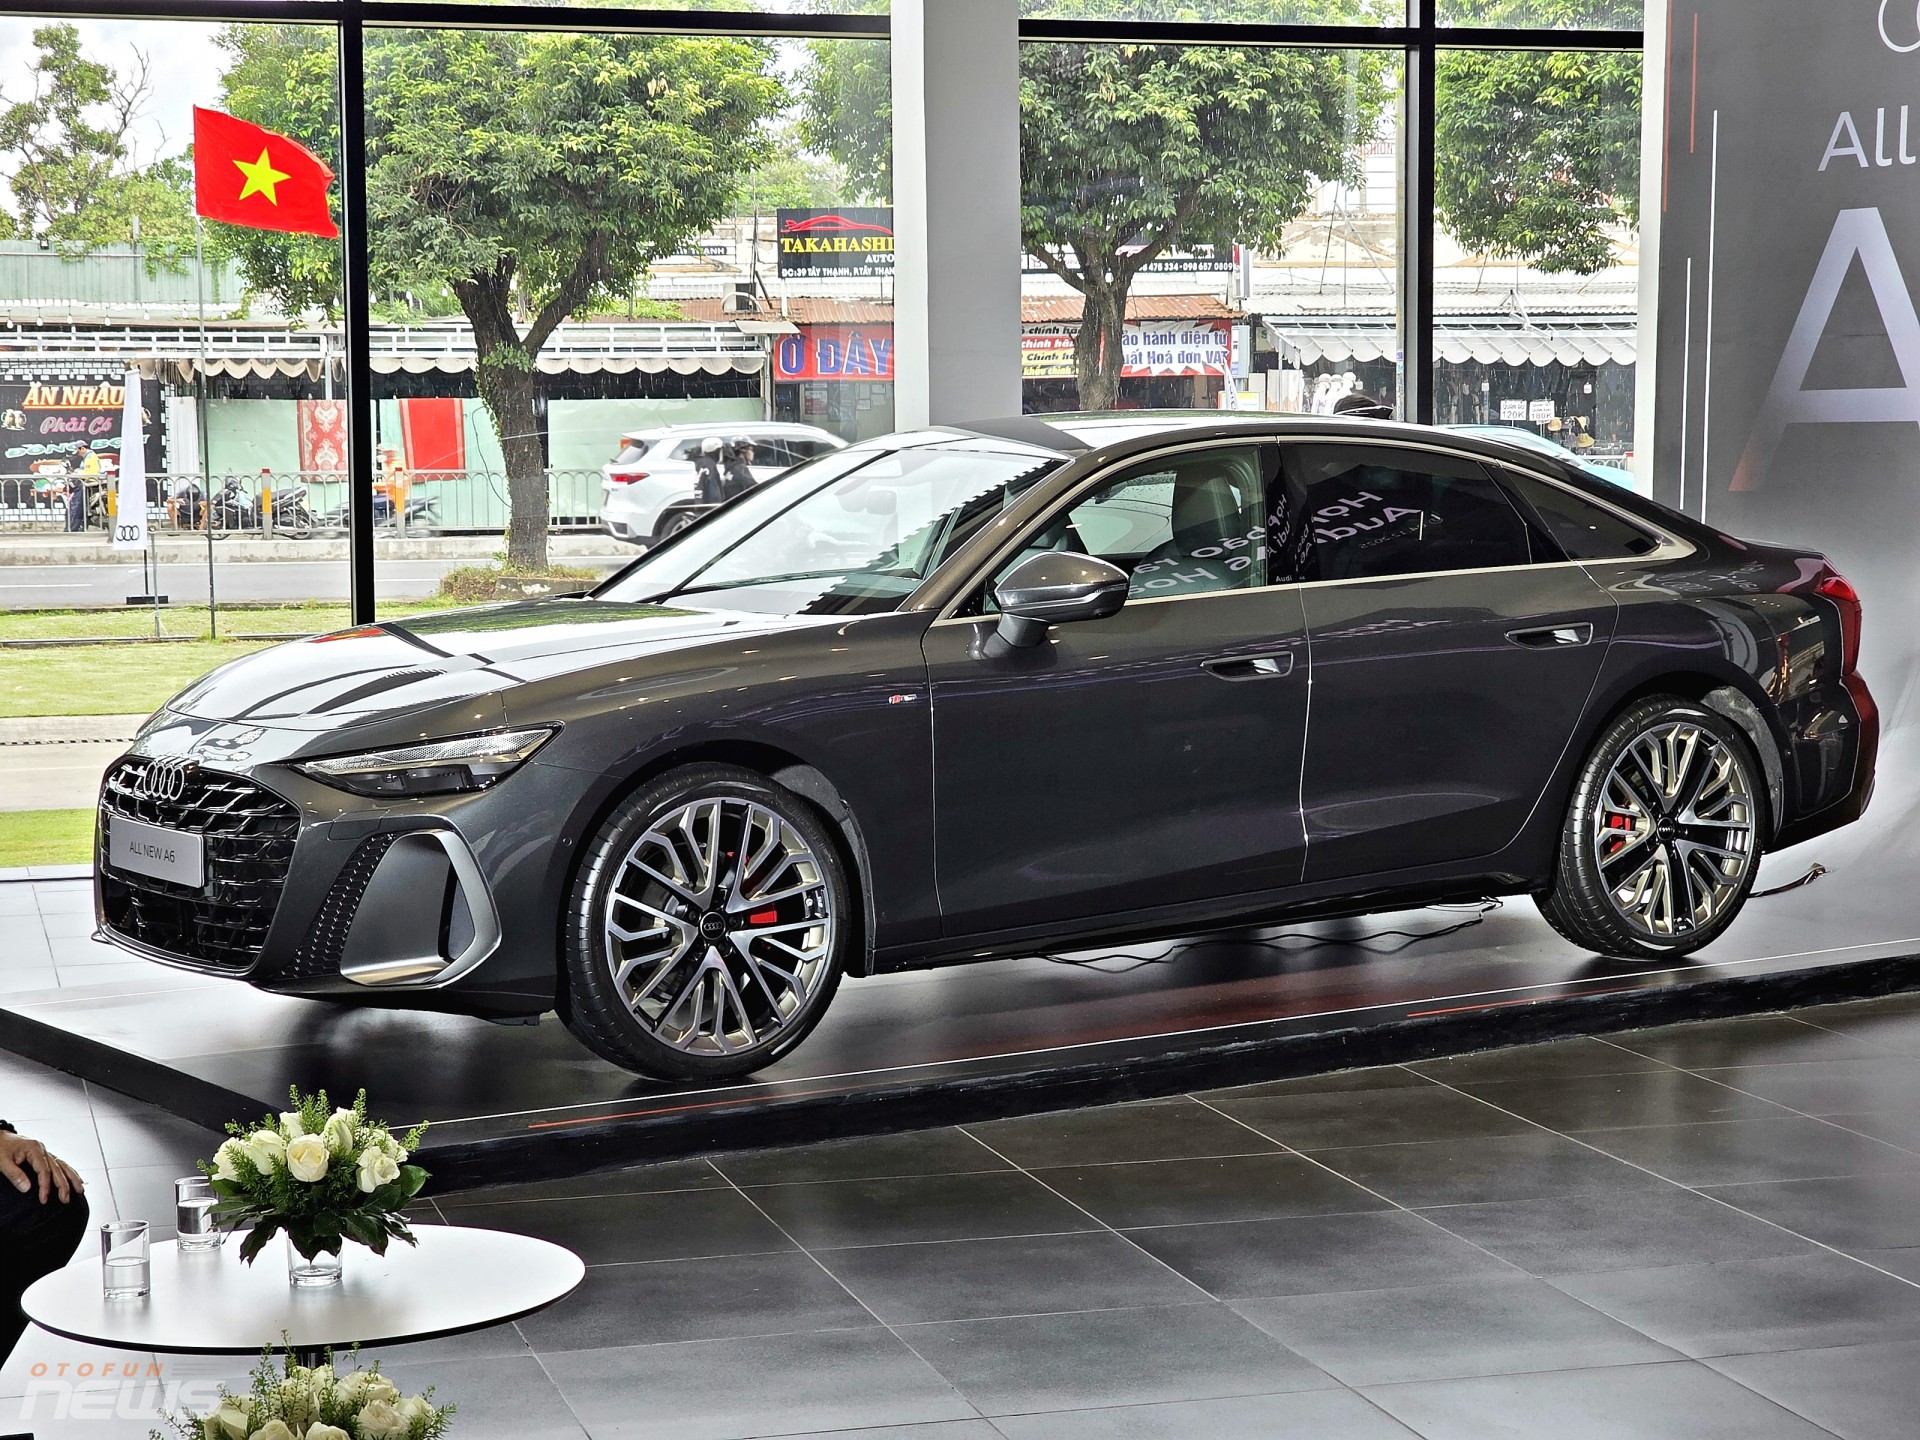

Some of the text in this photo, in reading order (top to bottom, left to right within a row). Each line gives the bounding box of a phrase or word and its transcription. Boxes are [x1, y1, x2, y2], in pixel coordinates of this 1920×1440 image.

[1817, 104, 1917, 172] All
[780, 236, 894, 253] TAKAHASHI
[865, 254, 894, 263] AUTO
[1121, 329, 1139, 346] ảo
[1142, 331, 1177, 346] hành
[1180, 330, 1210, 348] điện
[1213, 329, 1227, 345] tử
[816, 331, 892, 375] ĐÂY
[1147, 350, 1173, 365] Hoá
[1177, 350, 1202, 364] đơn
[1205, 350, 1228, 364] VAT
[23, 380, 60, 407] ĂN
[1502, 410, 1525, 419] 120K
[40, 415, 87, 435] Phải
[130, 841, 176, 863] ALL NEW A6
